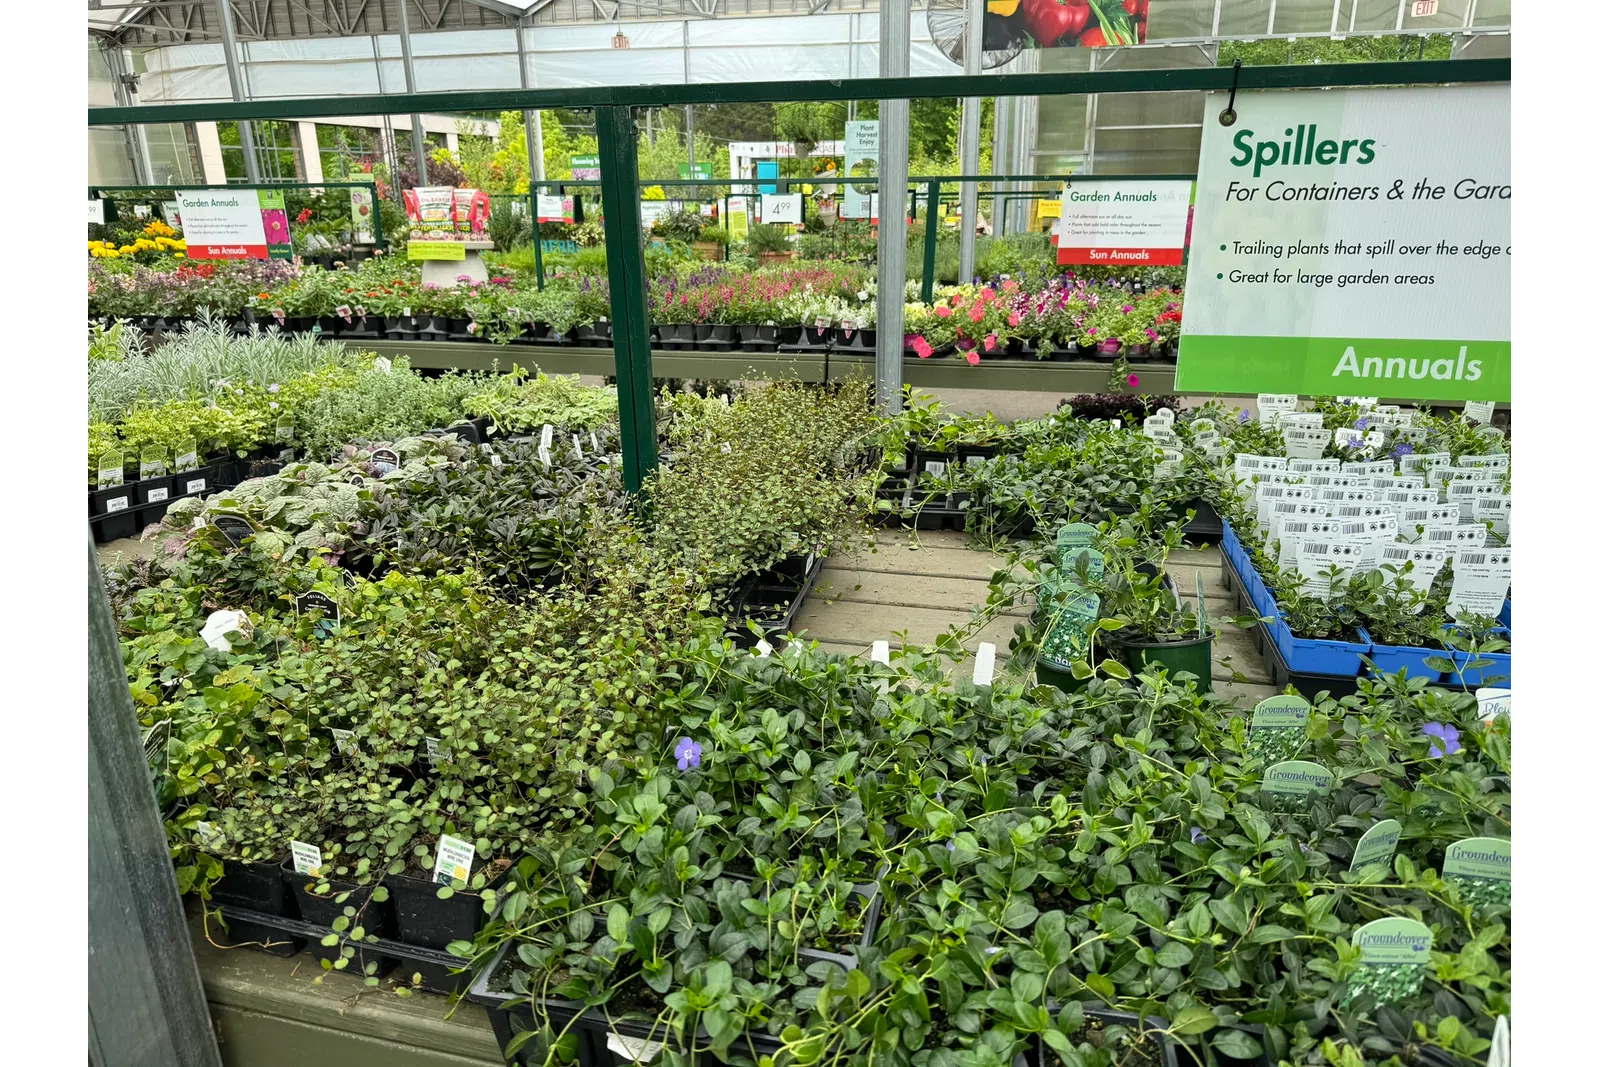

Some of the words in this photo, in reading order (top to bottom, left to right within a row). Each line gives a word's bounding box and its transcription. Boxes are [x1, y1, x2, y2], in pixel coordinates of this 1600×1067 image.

[1416, 1, 1435, 15] EXIT
[1230, 124, 1376, 178] Spillers
[1070, 191, 1110, 202] Garden
[1114, 190, 1157, 202] Annuals
[1226, 181, 1260, 201] For
[1265, 180, 1380, 201] Containers
[1386, 179, 1405, 200] &
[1412, 178, 1446, 200] the
[182, 198, 209, 208] Garden
[212, 198, 240, 208] Annuals
[208, 246, 220, 255] Sun
[221, 246, 247, 256] Annuals
[1090, 250, 1107, 260] Sun
[1110, 250, 1150, 260] Annuals
[1233, 240, 1283, 258] Trailing
[1287, 240, 1330, 258] plants
[1334, 240, 1362, 255] that
[1366, 239, 1394, 258] spill
[1399, 244, 1432, 256] over
[1436, 240, 1458, 255] the
[1463, 240, 1501, 260] edge
[1229, 270, 1269, 284] Great
[1273, 268, 1294, 284] for
[1297, 269, 1334, 288] large
[1338, 269, 1390, 288] garden
[1394, 274, 1436, 286] areas
[1332, 346, 1482, 381] Annuals
[1259, 705, 1308, 716] Groundcover
[1270, 769, 1330, 783] Groundcover
[1359, 931, 1429, 948] Groundcover
